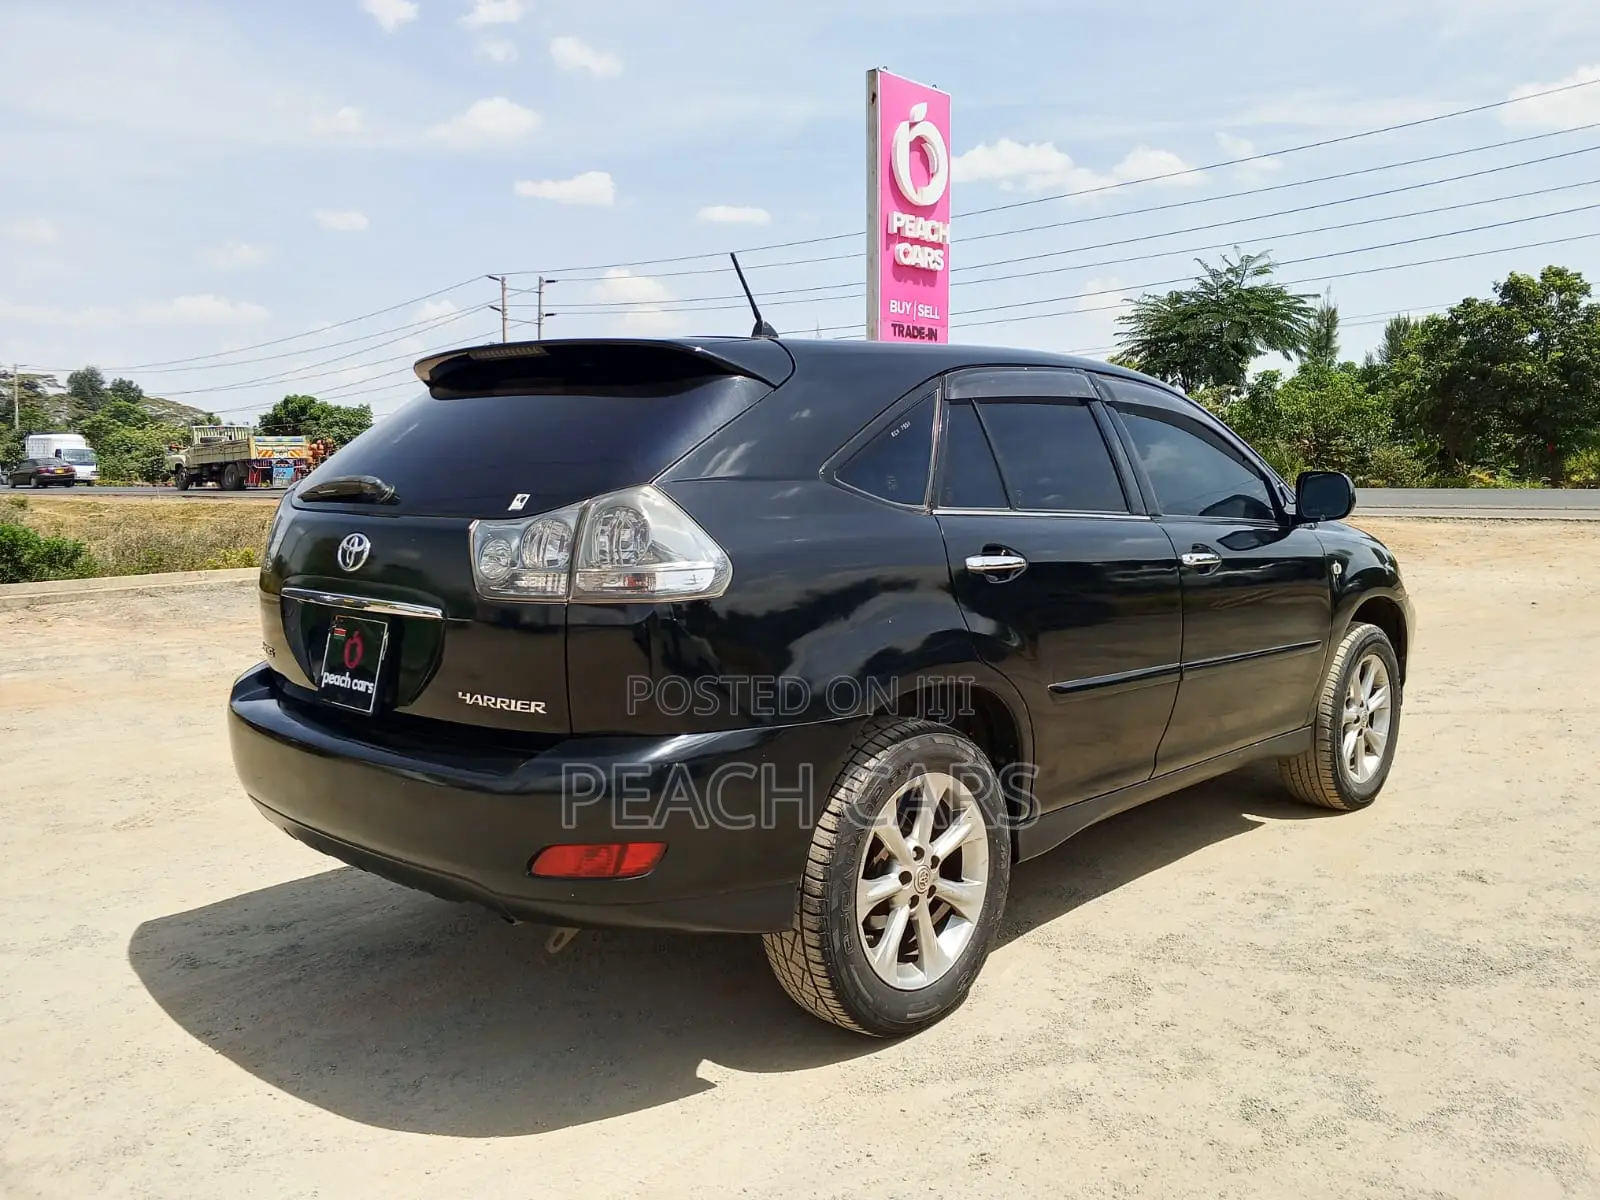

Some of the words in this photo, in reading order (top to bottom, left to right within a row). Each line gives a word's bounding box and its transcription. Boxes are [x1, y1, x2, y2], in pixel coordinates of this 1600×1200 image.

[888, 211, 950, 245] PEACH
[895, 242, 945, 272] CARS
[889, 299, 912, 315] BUY
[917, 303, 941, 320] SELL
[891, 323, 938, 342] TRADE-IN
[321, 671, 351, 688] peach
[352, 679, 374, 694] cars
[457, 691, 547, 714] HARRIER
